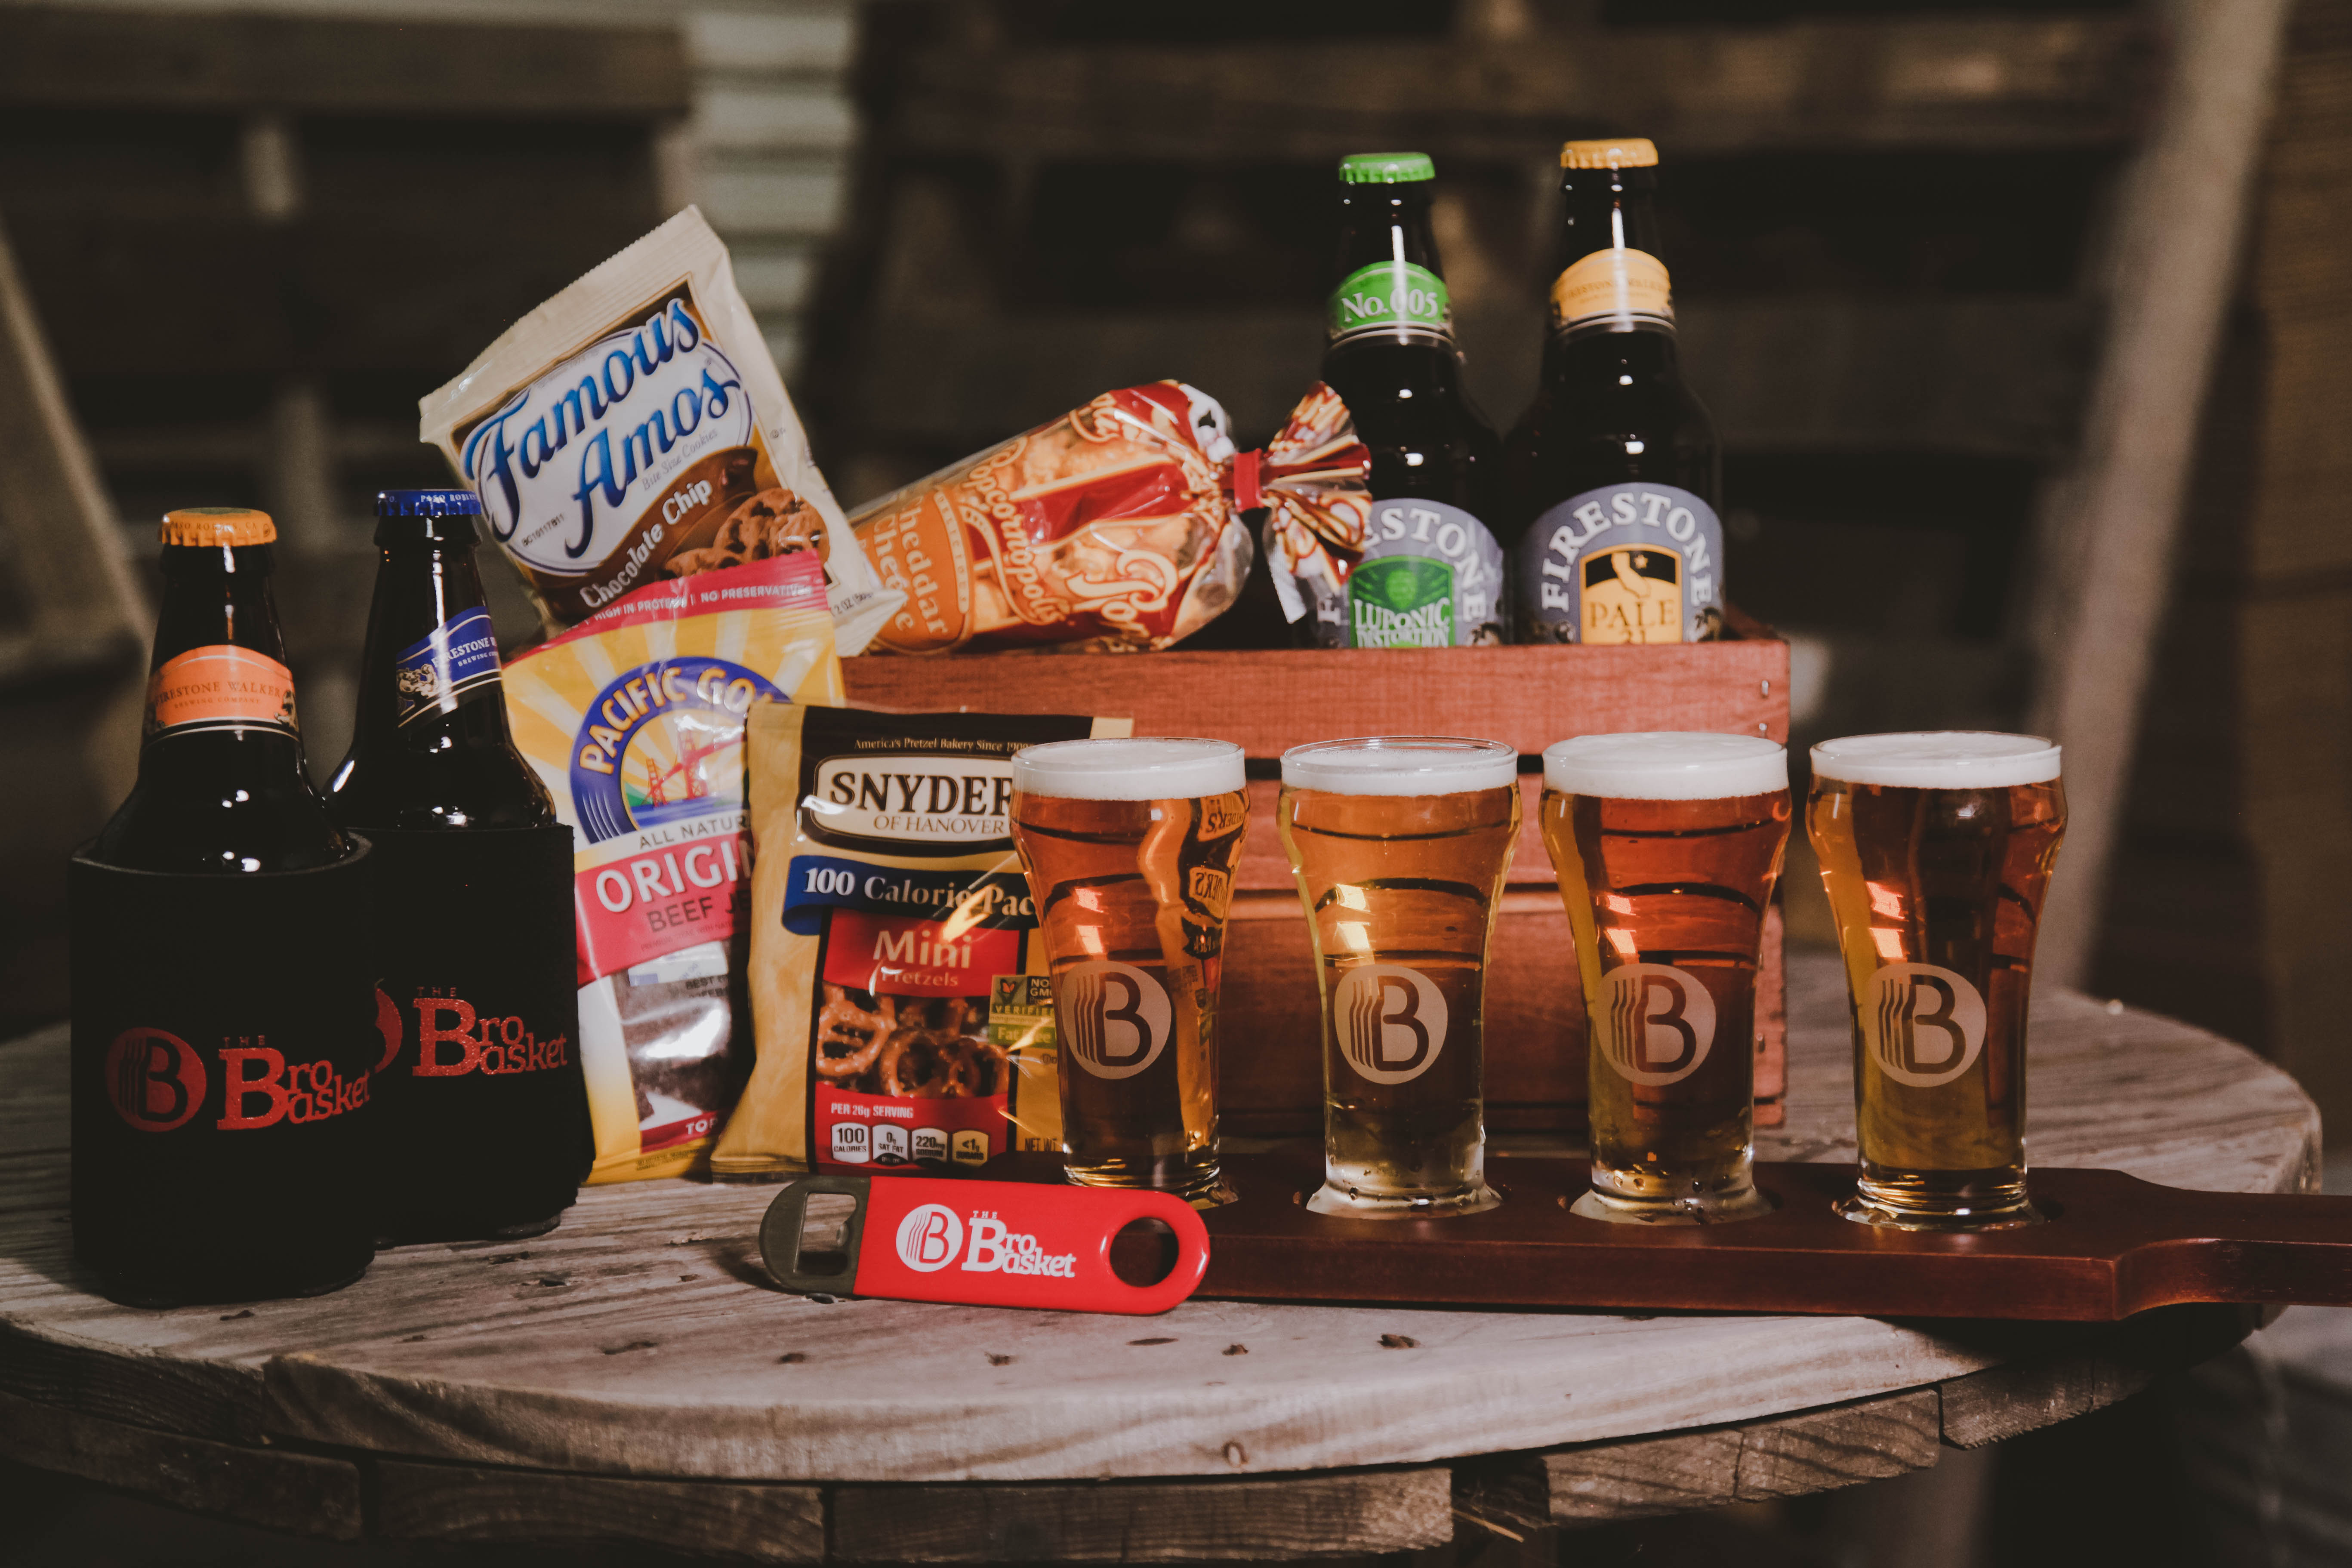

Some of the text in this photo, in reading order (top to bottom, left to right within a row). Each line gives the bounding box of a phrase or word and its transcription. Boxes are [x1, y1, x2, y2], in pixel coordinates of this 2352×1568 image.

[1341, 289, 1438, 322] No. 005
[463, 302, 699, 542] Famous
[682, 428, 718, 458] Cookies
[564, 369, 740, 559] Amos
[580, 480, 712, 608] Chocolate Chip
[1541, 492, 1712, 613] FIRESTONE
[872, 518, 916, 632] Cheee
[623, 603, 635, 614] IN
[700, 592, 718, 603] NO
[721, 584, 814, 600] PRESERVATIV
[1353, 597, 1451, 629] LUPONIC
[1589, 599, 1676, 628] PALE
[431, 637, 490, 668] FRESTONE
[457, 652, 488, 667] BREWING
[154, 680, 281, 708] FIRESTONE WALKER
[217, 696, 260, 705] COMPANY
[579, 666, 686, 774] PACIFIC
[854, 736, 901, 749] America's
[903, 736, 937, 749] Pretzel
[940, 738, 974, 753] Bakery
[976, 739, 1002, 752] Since
[873, 815, 1004, 835] OF HANOVER
[639, 829, 674, 850] ALL
[804, 867, 855, 896] 100
[864, 877, 971, 909] Calorie
[647, 896, 713, 933] BEEF
[872, 930, 971, 969] Mini
[881, 968, 959, 987] Pretzels
[416, 986, 457, 998] THE
[223, 1035, 265, 1047] THE
[1022, 1028, 1051, 1044] Fee
[831, 1103, 851, 1114] PER
[872, 1105, 914, 1119] SERVING
[837, 1127, 864, 1143] 100
[878, 1143, 904, 1153] SAT FAT
[1024, 1137, 1057, 1152] NET WT
[916, 1149, 943, 1157] SODIUM
[972, 1210, 998, 1219] THE
